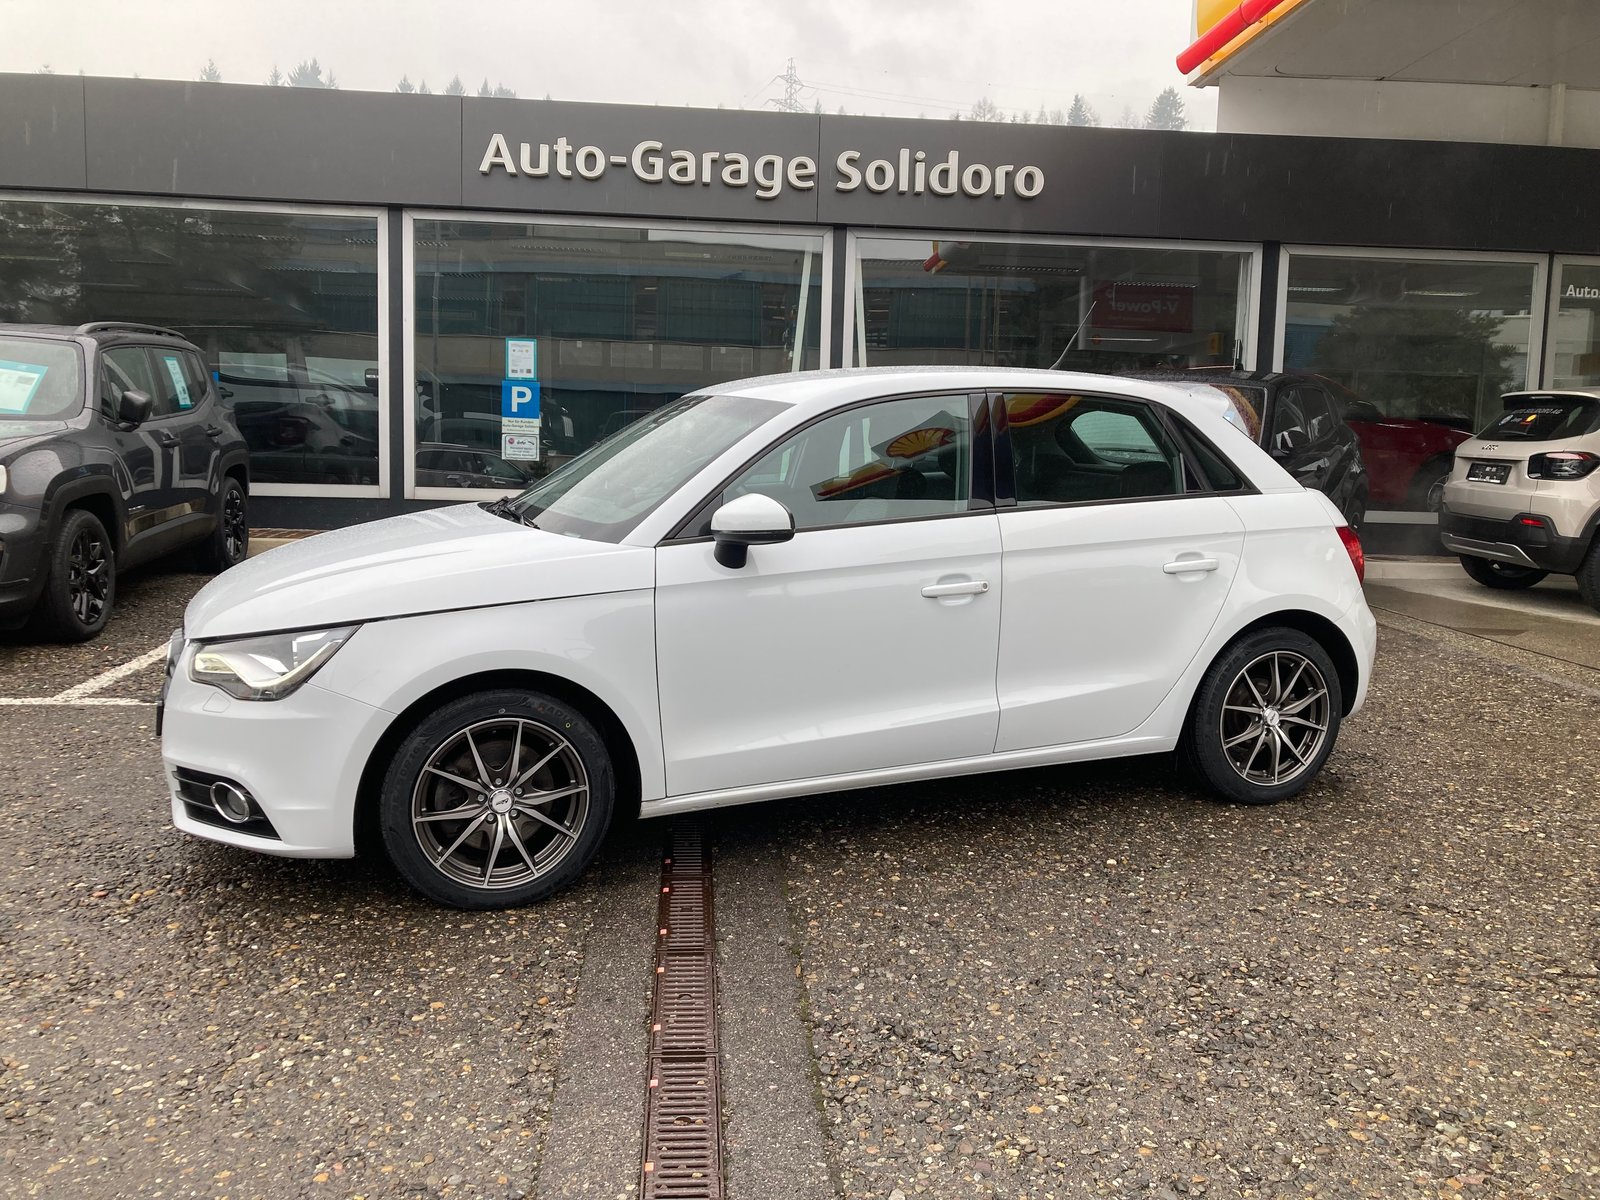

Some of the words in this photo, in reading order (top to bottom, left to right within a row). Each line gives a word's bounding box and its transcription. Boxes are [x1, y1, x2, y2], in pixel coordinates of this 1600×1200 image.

[478, 133, 816, 200] Auto-Garage
[835, 148, 1045, 199] Solidoro
[1565, 284, 1600, 298] Auto
[511, 386, 532, 413] P
